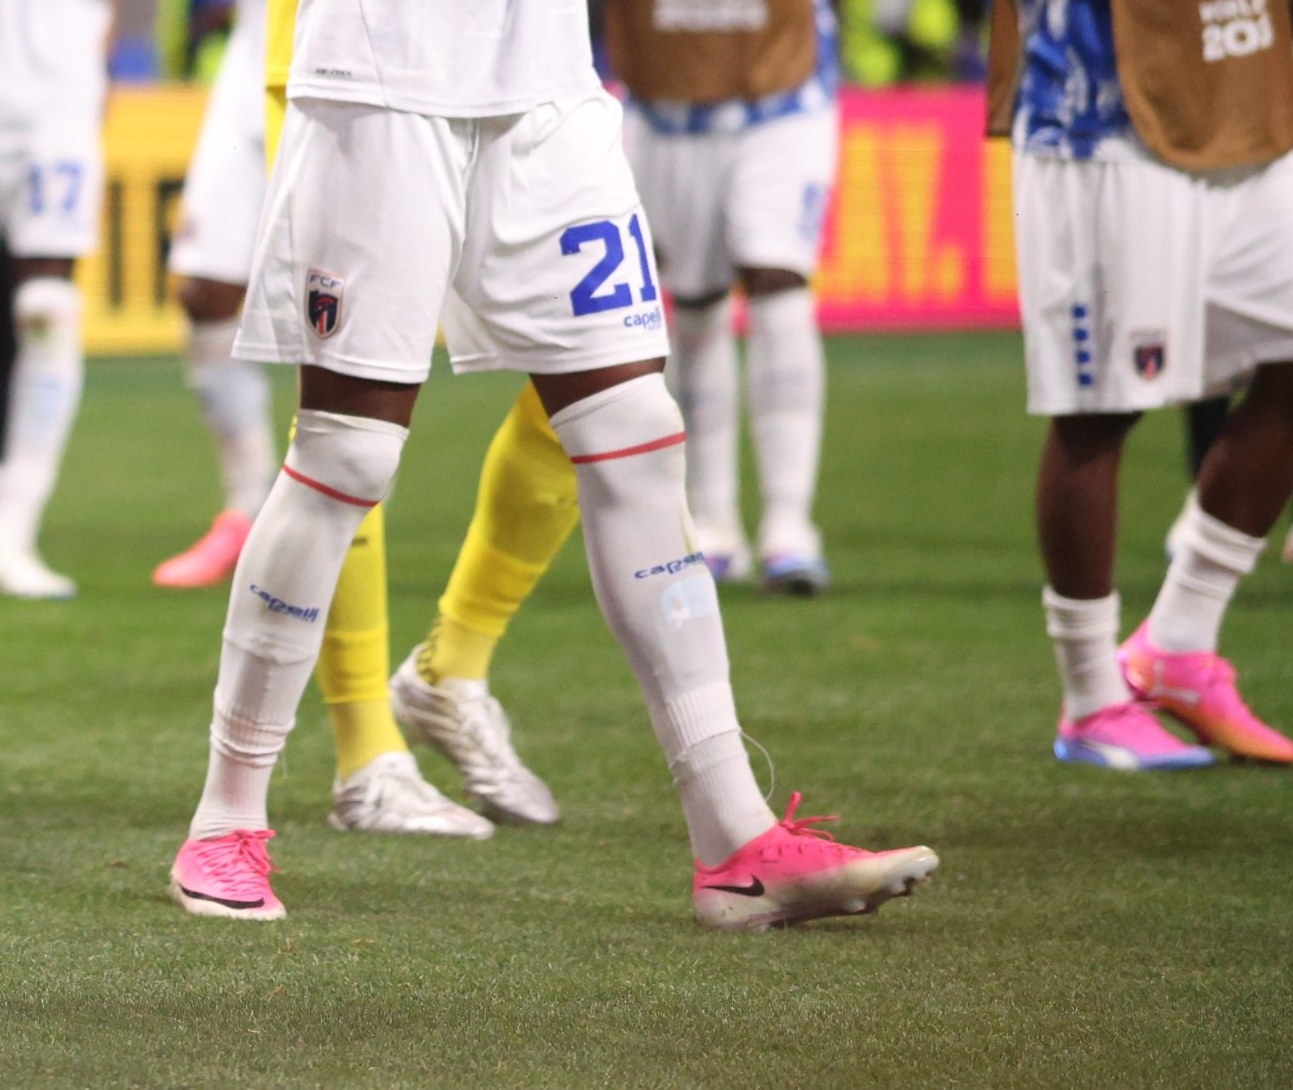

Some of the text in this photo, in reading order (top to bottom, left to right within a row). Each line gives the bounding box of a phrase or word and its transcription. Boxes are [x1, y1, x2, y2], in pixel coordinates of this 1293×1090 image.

[310, 274, 341, 289] FCF
[559, 213, 657, 317] 21
[250, 584, 320, 622] capelli
